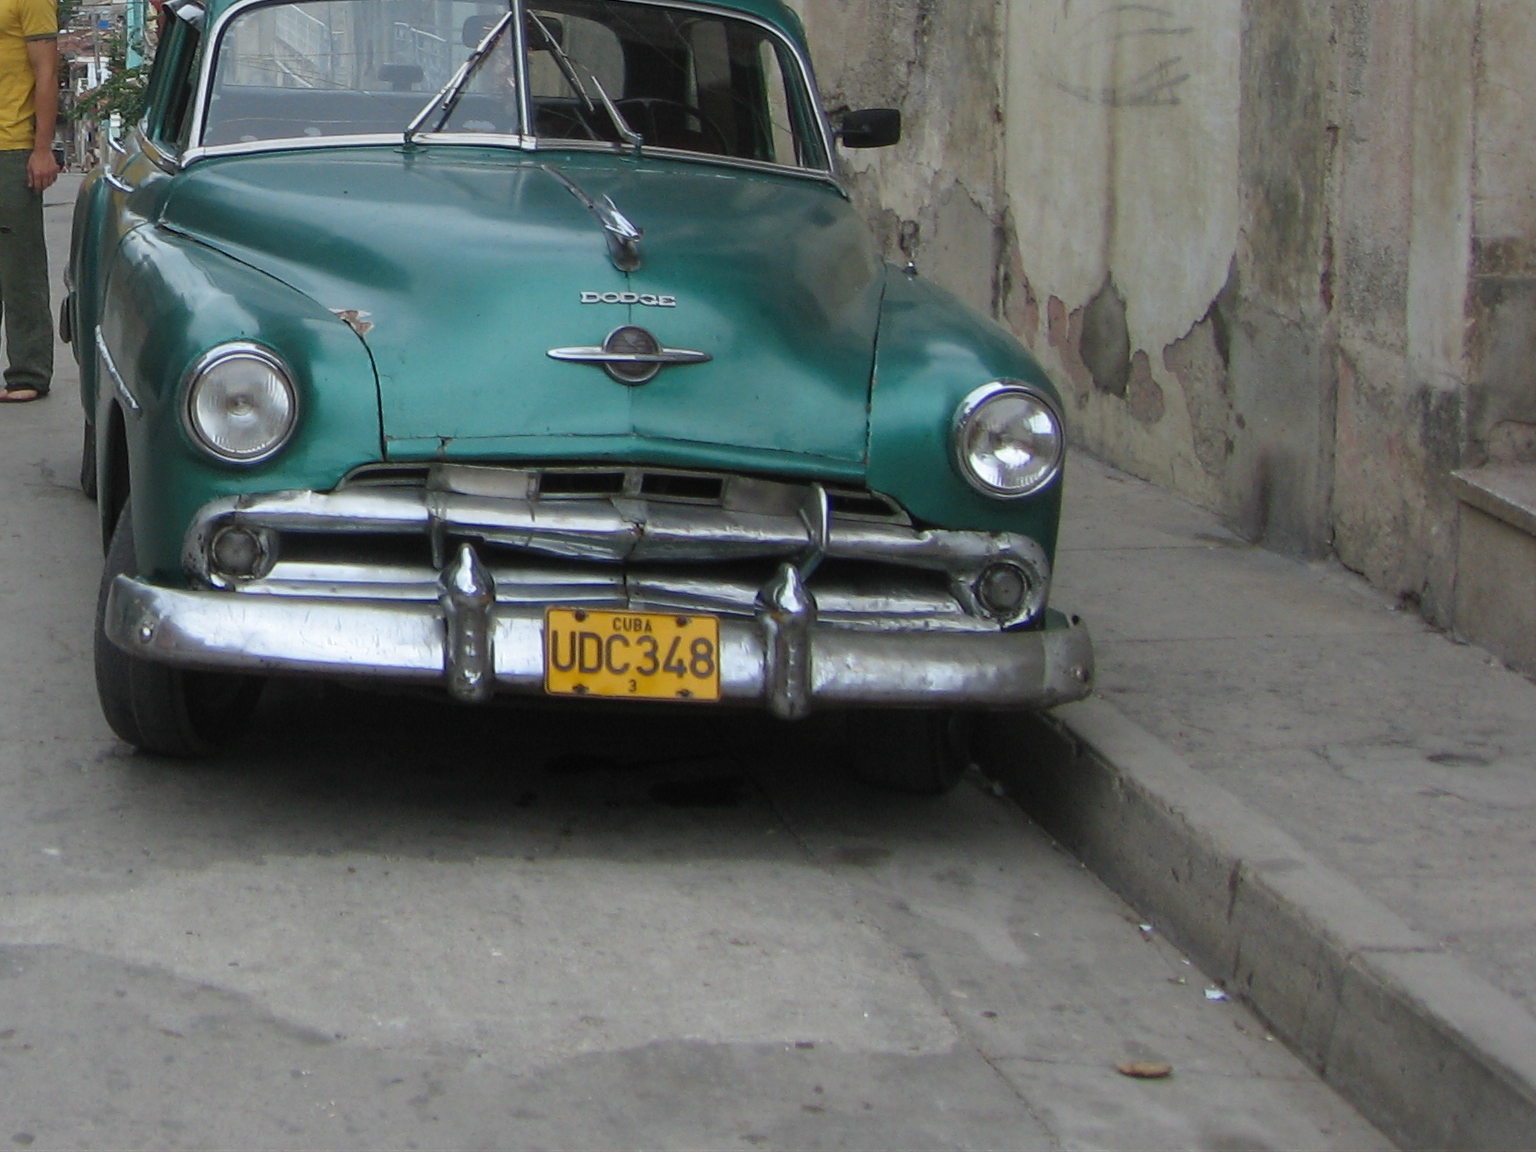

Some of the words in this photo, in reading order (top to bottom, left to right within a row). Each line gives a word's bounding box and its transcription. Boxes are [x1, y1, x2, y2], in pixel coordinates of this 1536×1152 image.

[580, 291, 677, 308] DODGE
[612, 617, 653, 633] CUBA
[550, 630, 715, 679] UDC348
[628, 679, 638, 693] 3
